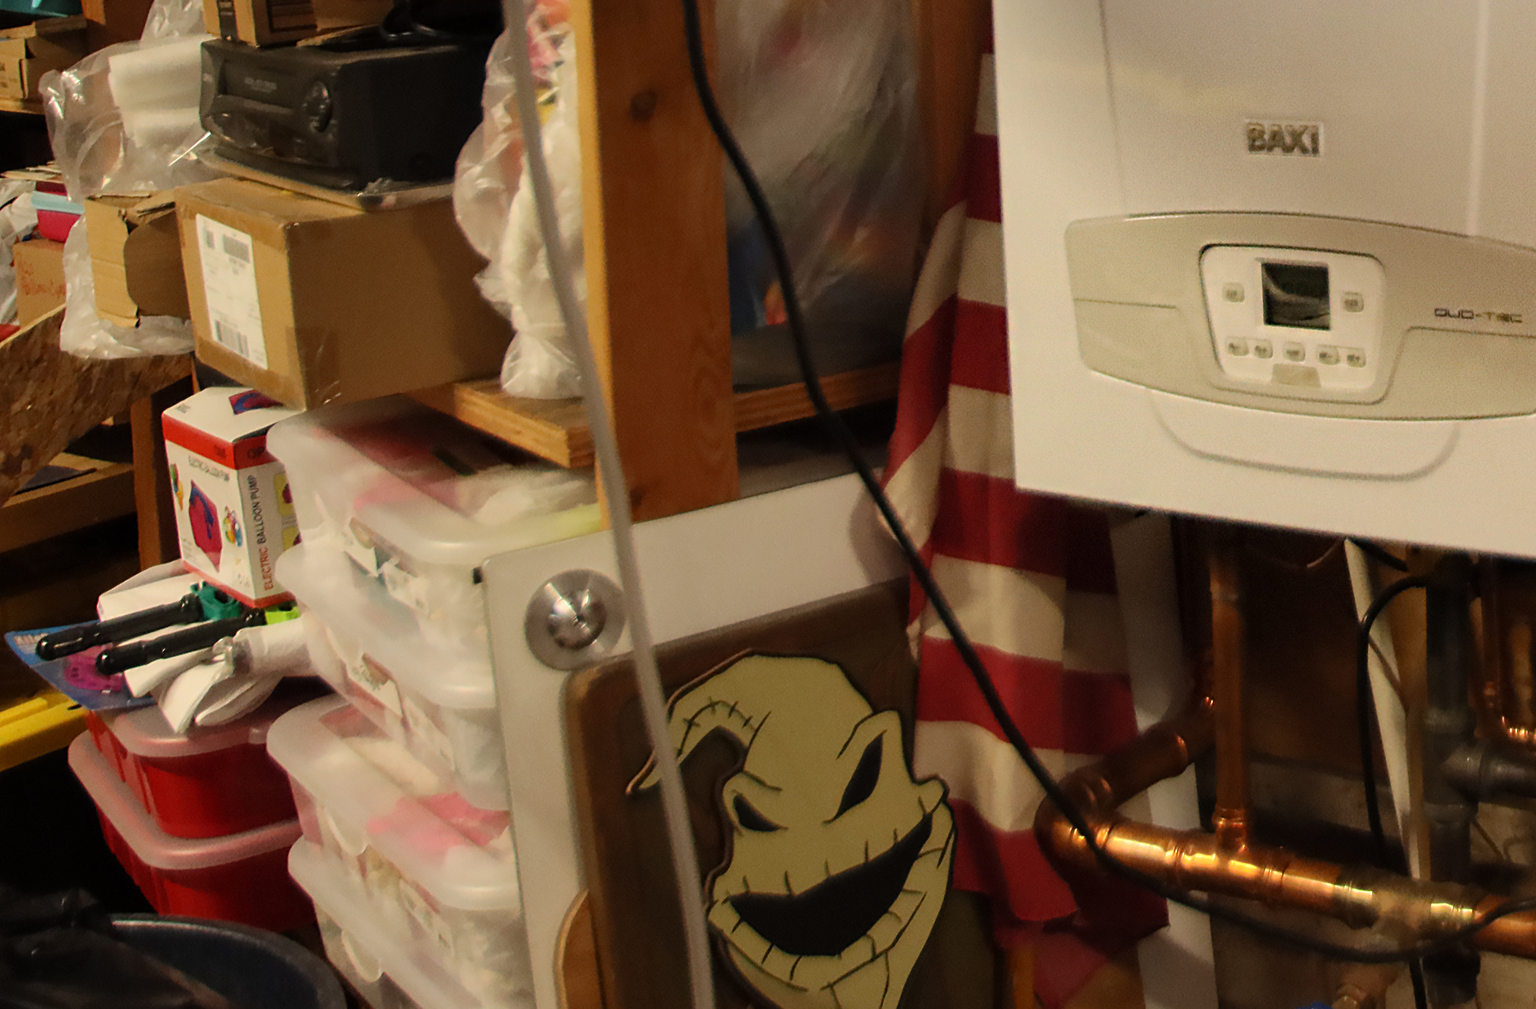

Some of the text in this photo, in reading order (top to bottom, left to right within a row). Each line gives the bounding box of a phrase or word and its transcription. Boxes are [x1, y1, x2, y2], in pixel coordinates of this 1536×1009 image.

[1246, 121, 1320, 156] BAXI
[247, 474, 274, 591] ELECTRIC BALLOON PUMP
